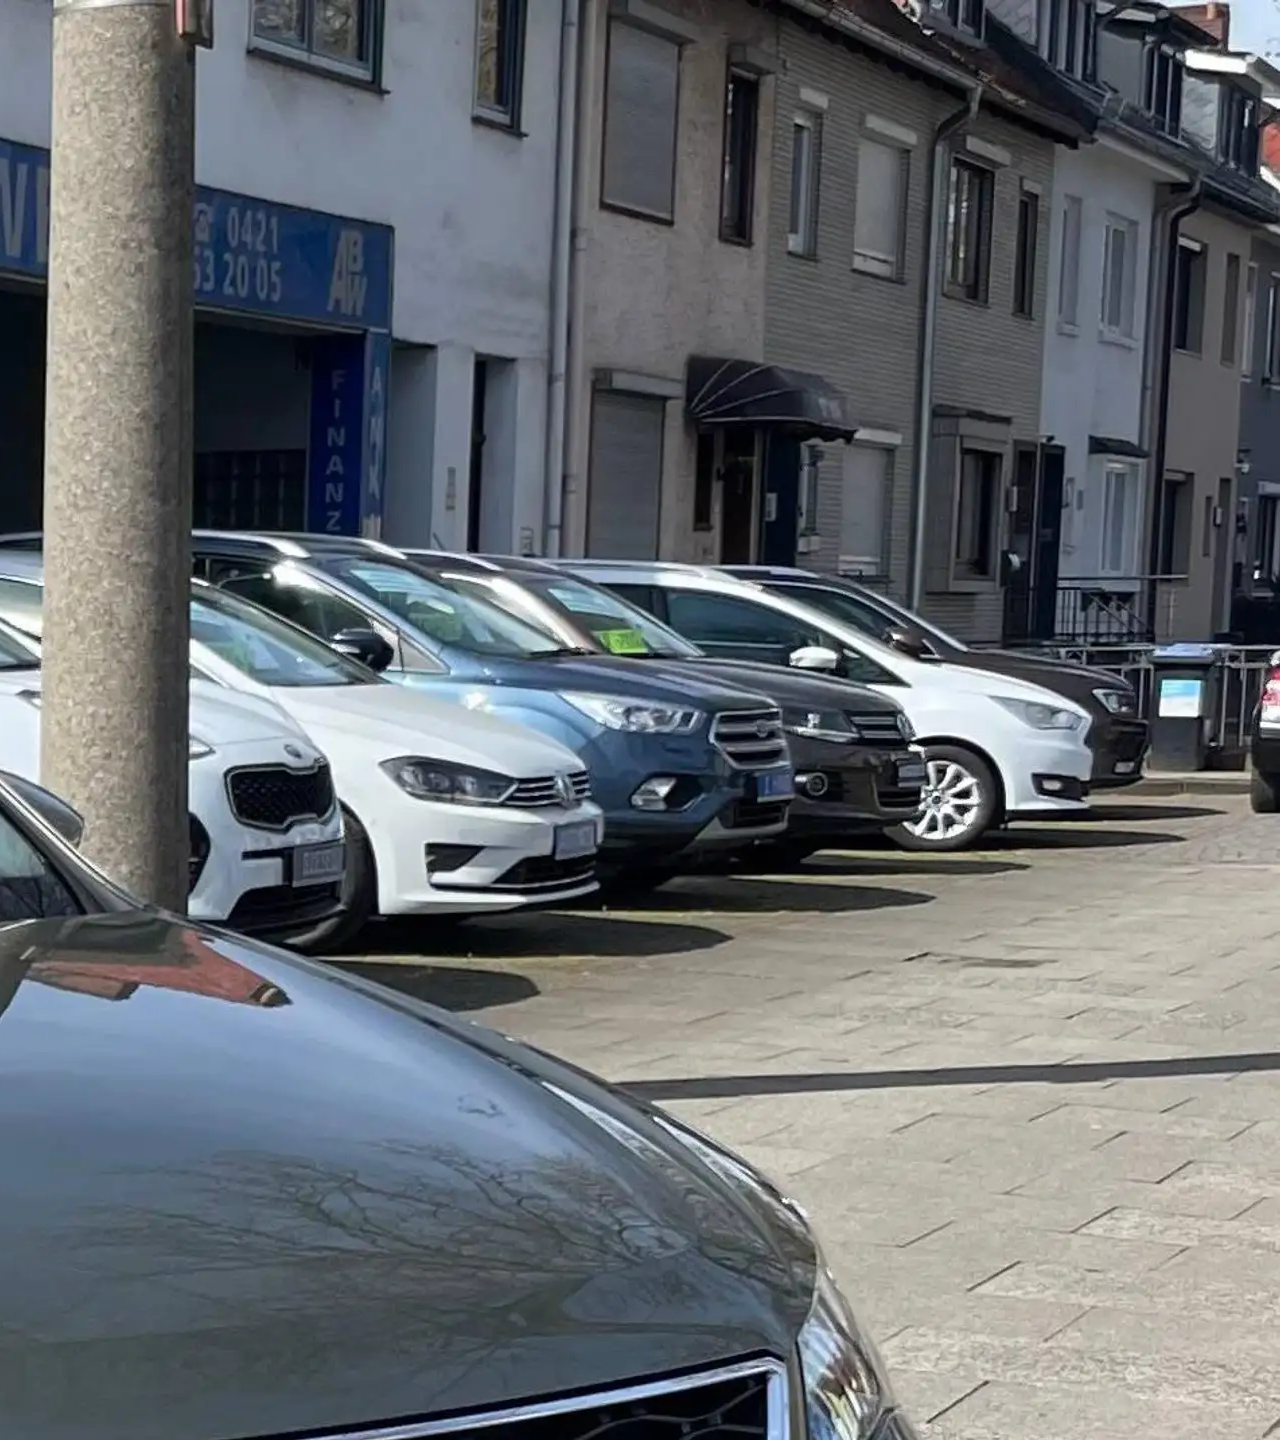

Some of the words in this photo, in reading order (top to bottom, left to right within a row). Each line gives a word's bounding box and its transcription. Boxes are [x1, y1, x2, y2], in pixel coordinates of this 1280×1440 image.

[226, 206, 279, 254] 0421
[222, 253, 250, 298] 20
[255, 258, 282, 303] 05
